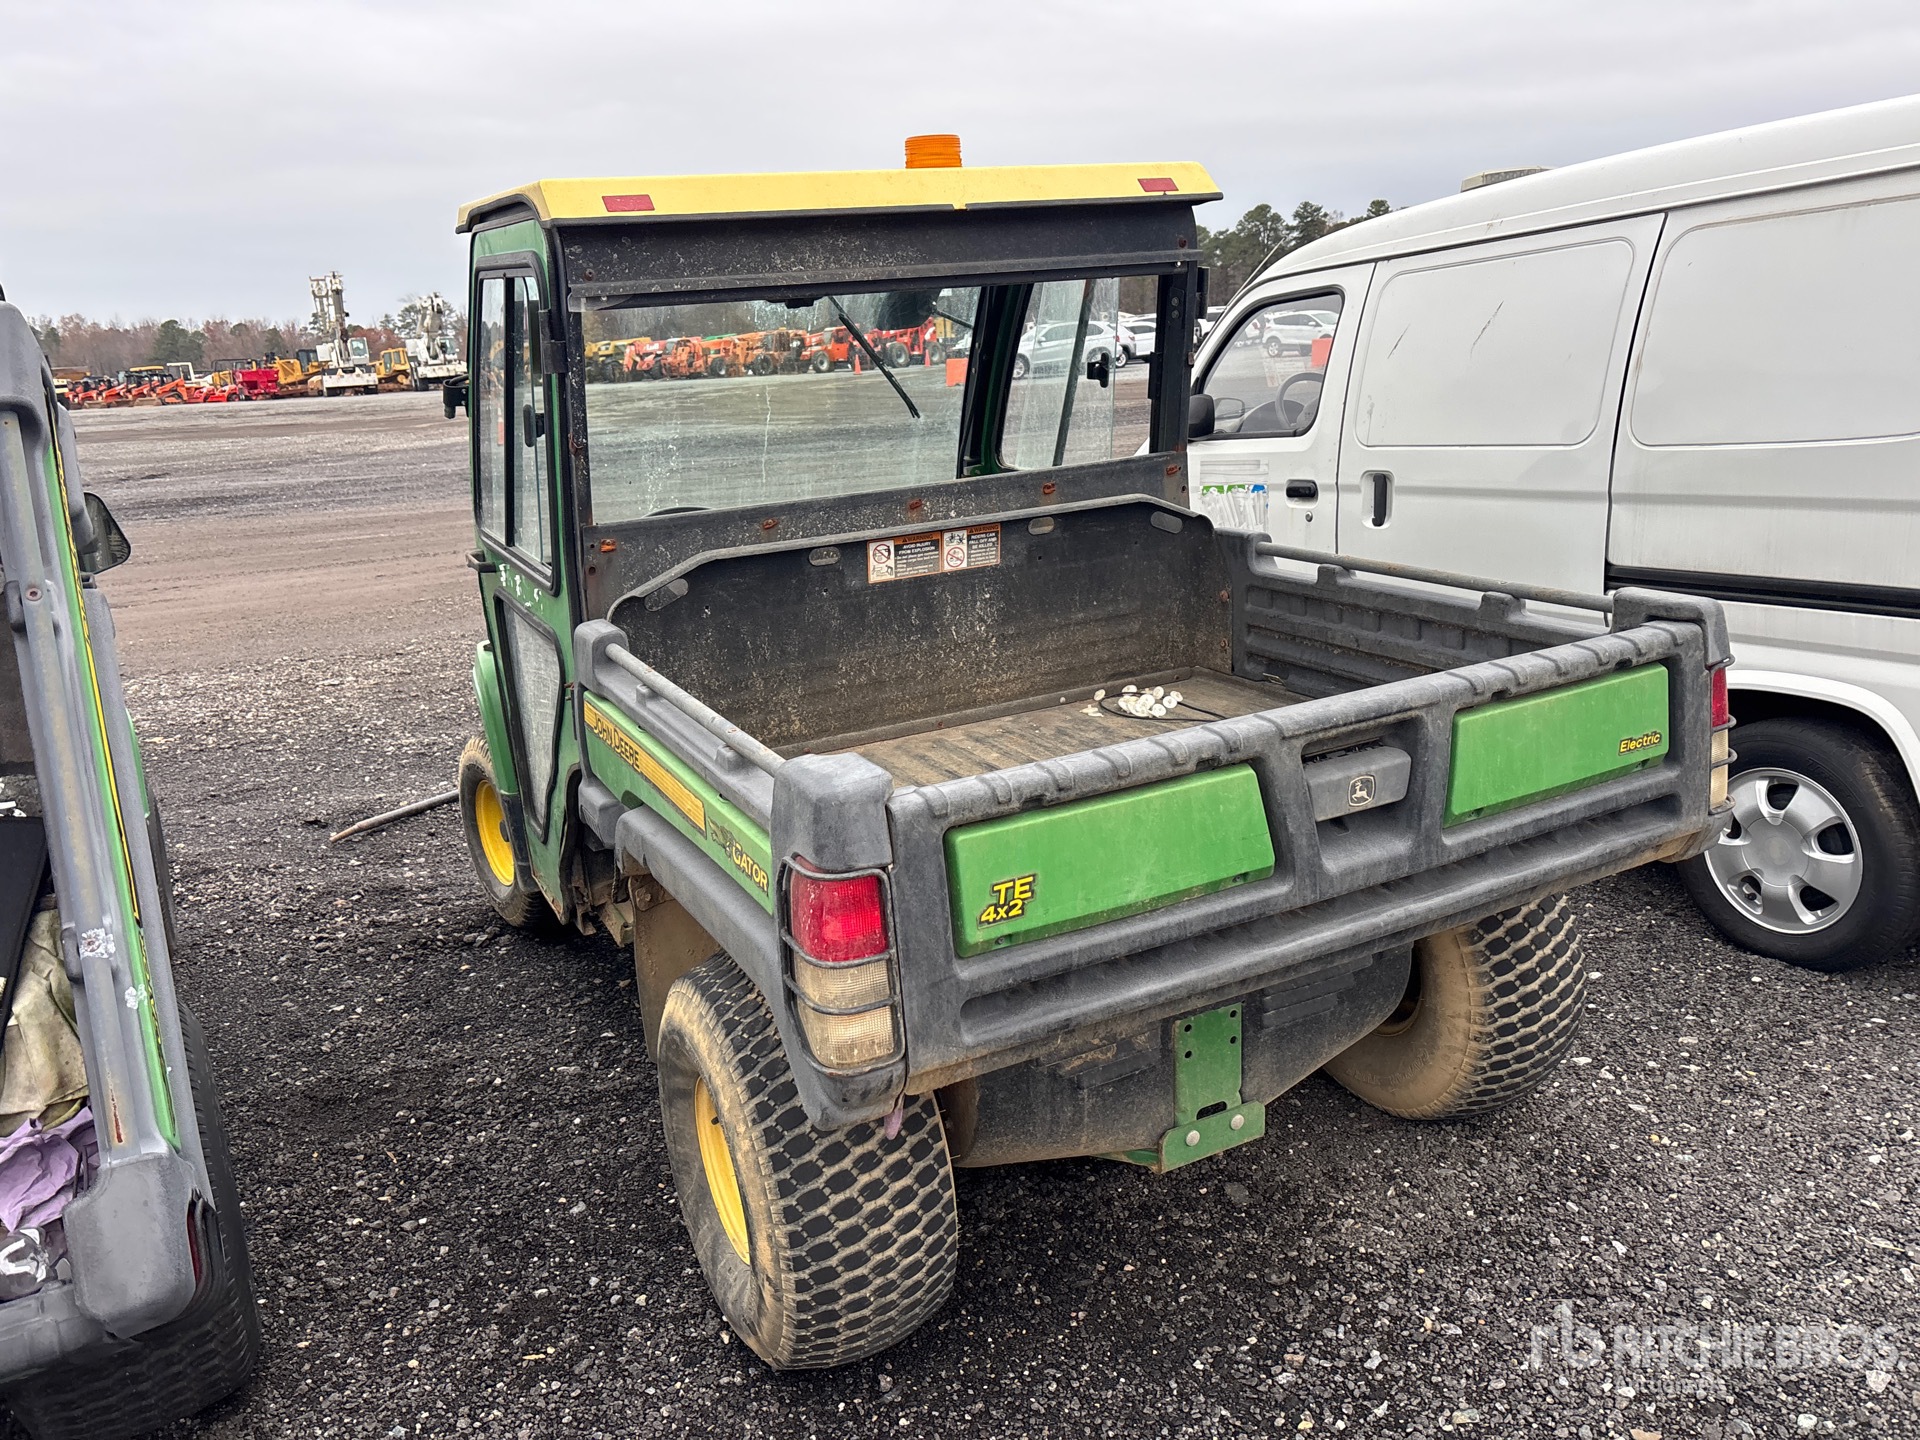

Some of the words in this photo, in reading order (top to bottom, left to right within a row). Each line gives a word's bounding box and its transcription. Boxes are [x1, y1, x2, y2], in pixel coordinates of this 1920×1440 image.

[593, 712, 612, 746] JOHN
[613, 726, 640, 770] DEERE
[1619, 732, 1661, 753] Electric
[731, 841, 769, 893] GATOR
[992, 875, 1035, 905] TE
[979, 898, 1024, 923] 4x2
